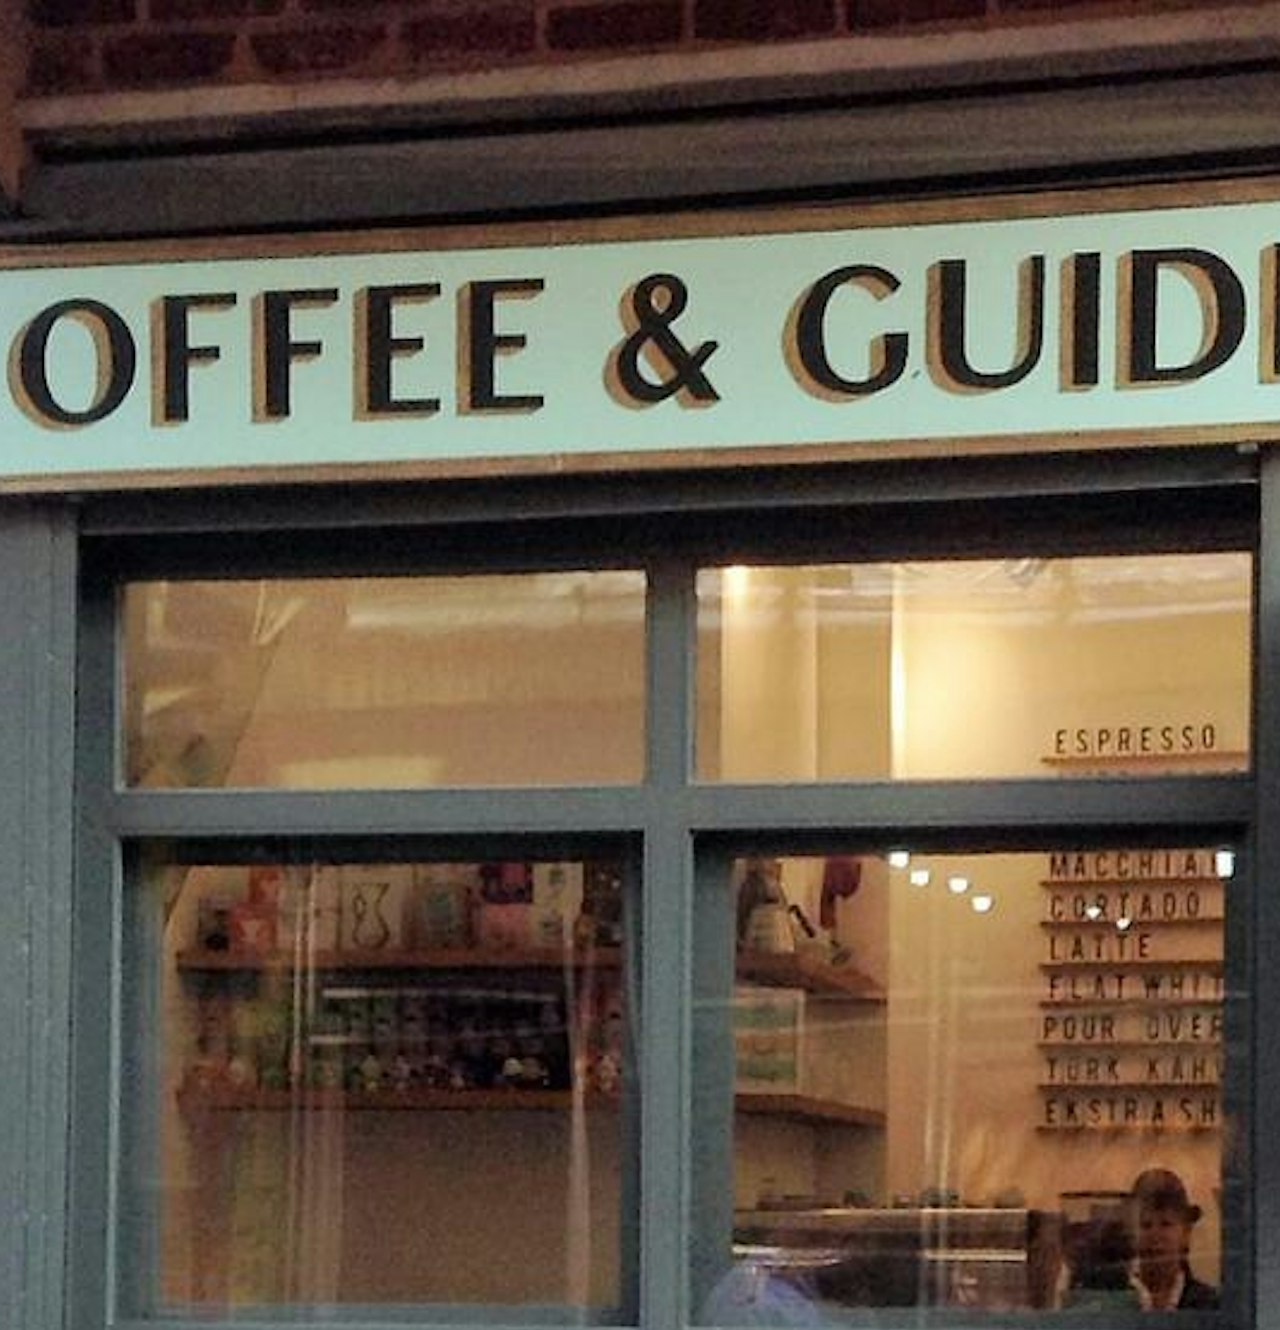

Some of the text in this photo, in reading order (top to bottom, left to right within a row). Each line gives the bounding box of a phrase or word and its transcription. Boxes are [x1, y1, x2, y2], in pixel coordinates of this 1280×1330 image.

[602, 271, 721, 410] &
[1054, 723, 1216, 754] ESPRESSO
[1049, 852, 1217, 877] MACCHIA
[1049, 890, 1200, 920] CORTADO
[1049, 933, 1151, 960] LATTE
[1049, 974, 1126, 999] FLAT
[1043, 1015, 1116, 1041] POUR
[1045, 1098, 1165, 1125] EKSTRA
